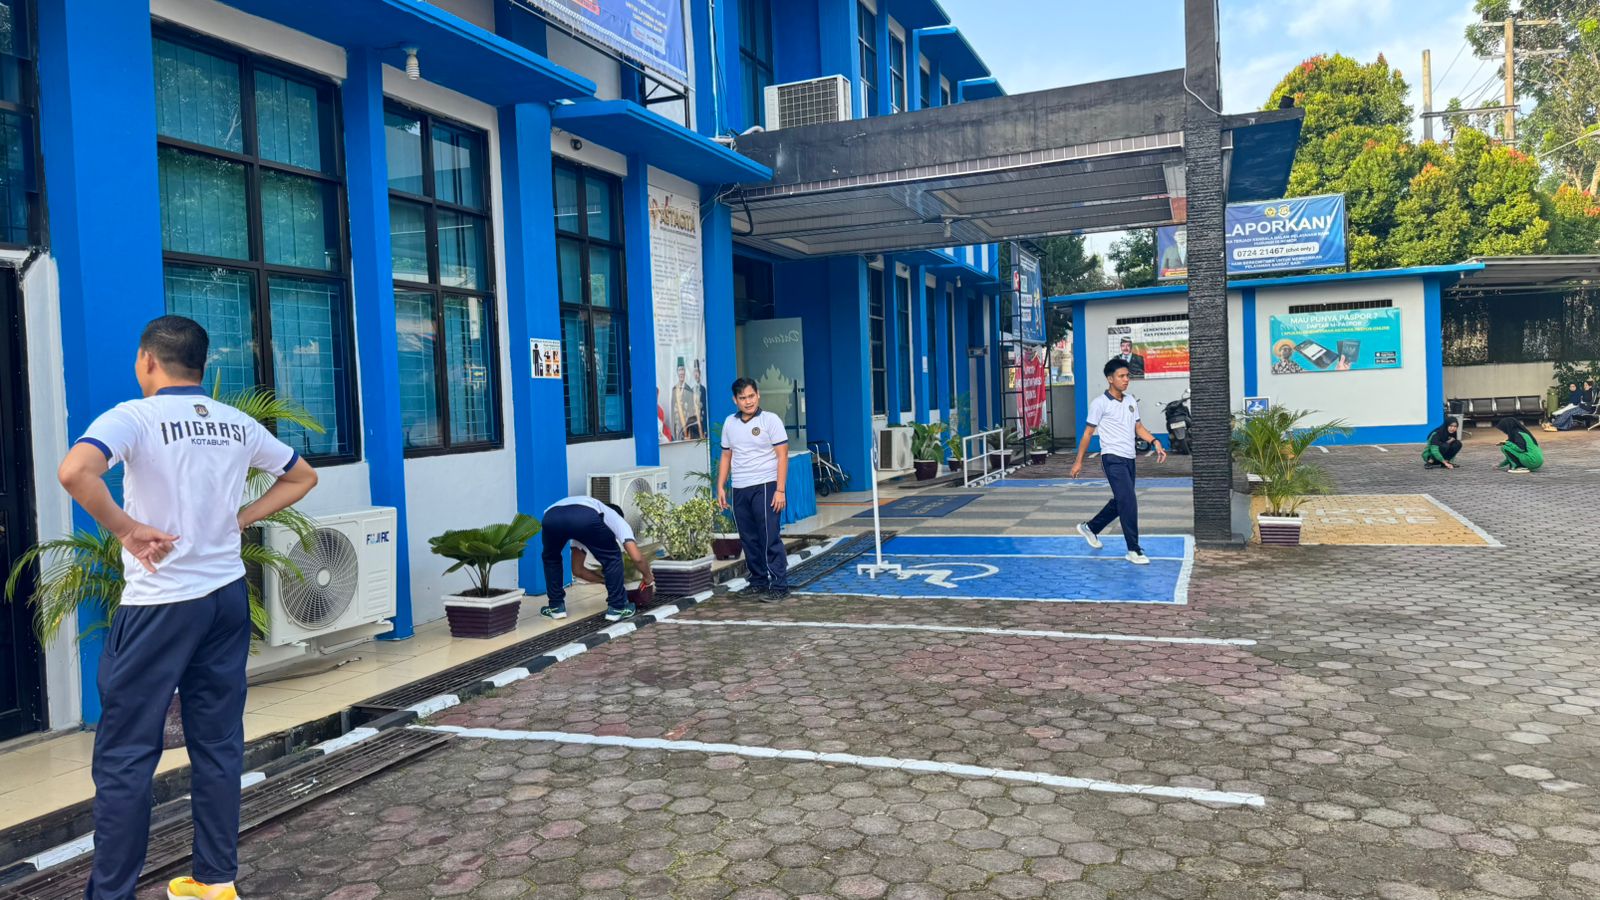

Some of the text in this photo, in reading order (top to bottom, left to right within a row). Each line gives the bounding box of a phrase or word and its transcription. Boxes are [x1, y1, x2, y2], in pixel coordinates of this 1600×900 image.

[1237, 249, 1257, 258] 0724
[1259, 247, 1285, 256] 21467
[1310, 315, 1338, 323] PUNYA
[1339, 312, 1372, 321] PASPOR
[160, 420, 247, 447] IMIGRASI
[191, 438, 230, 446] KOTABUMI
